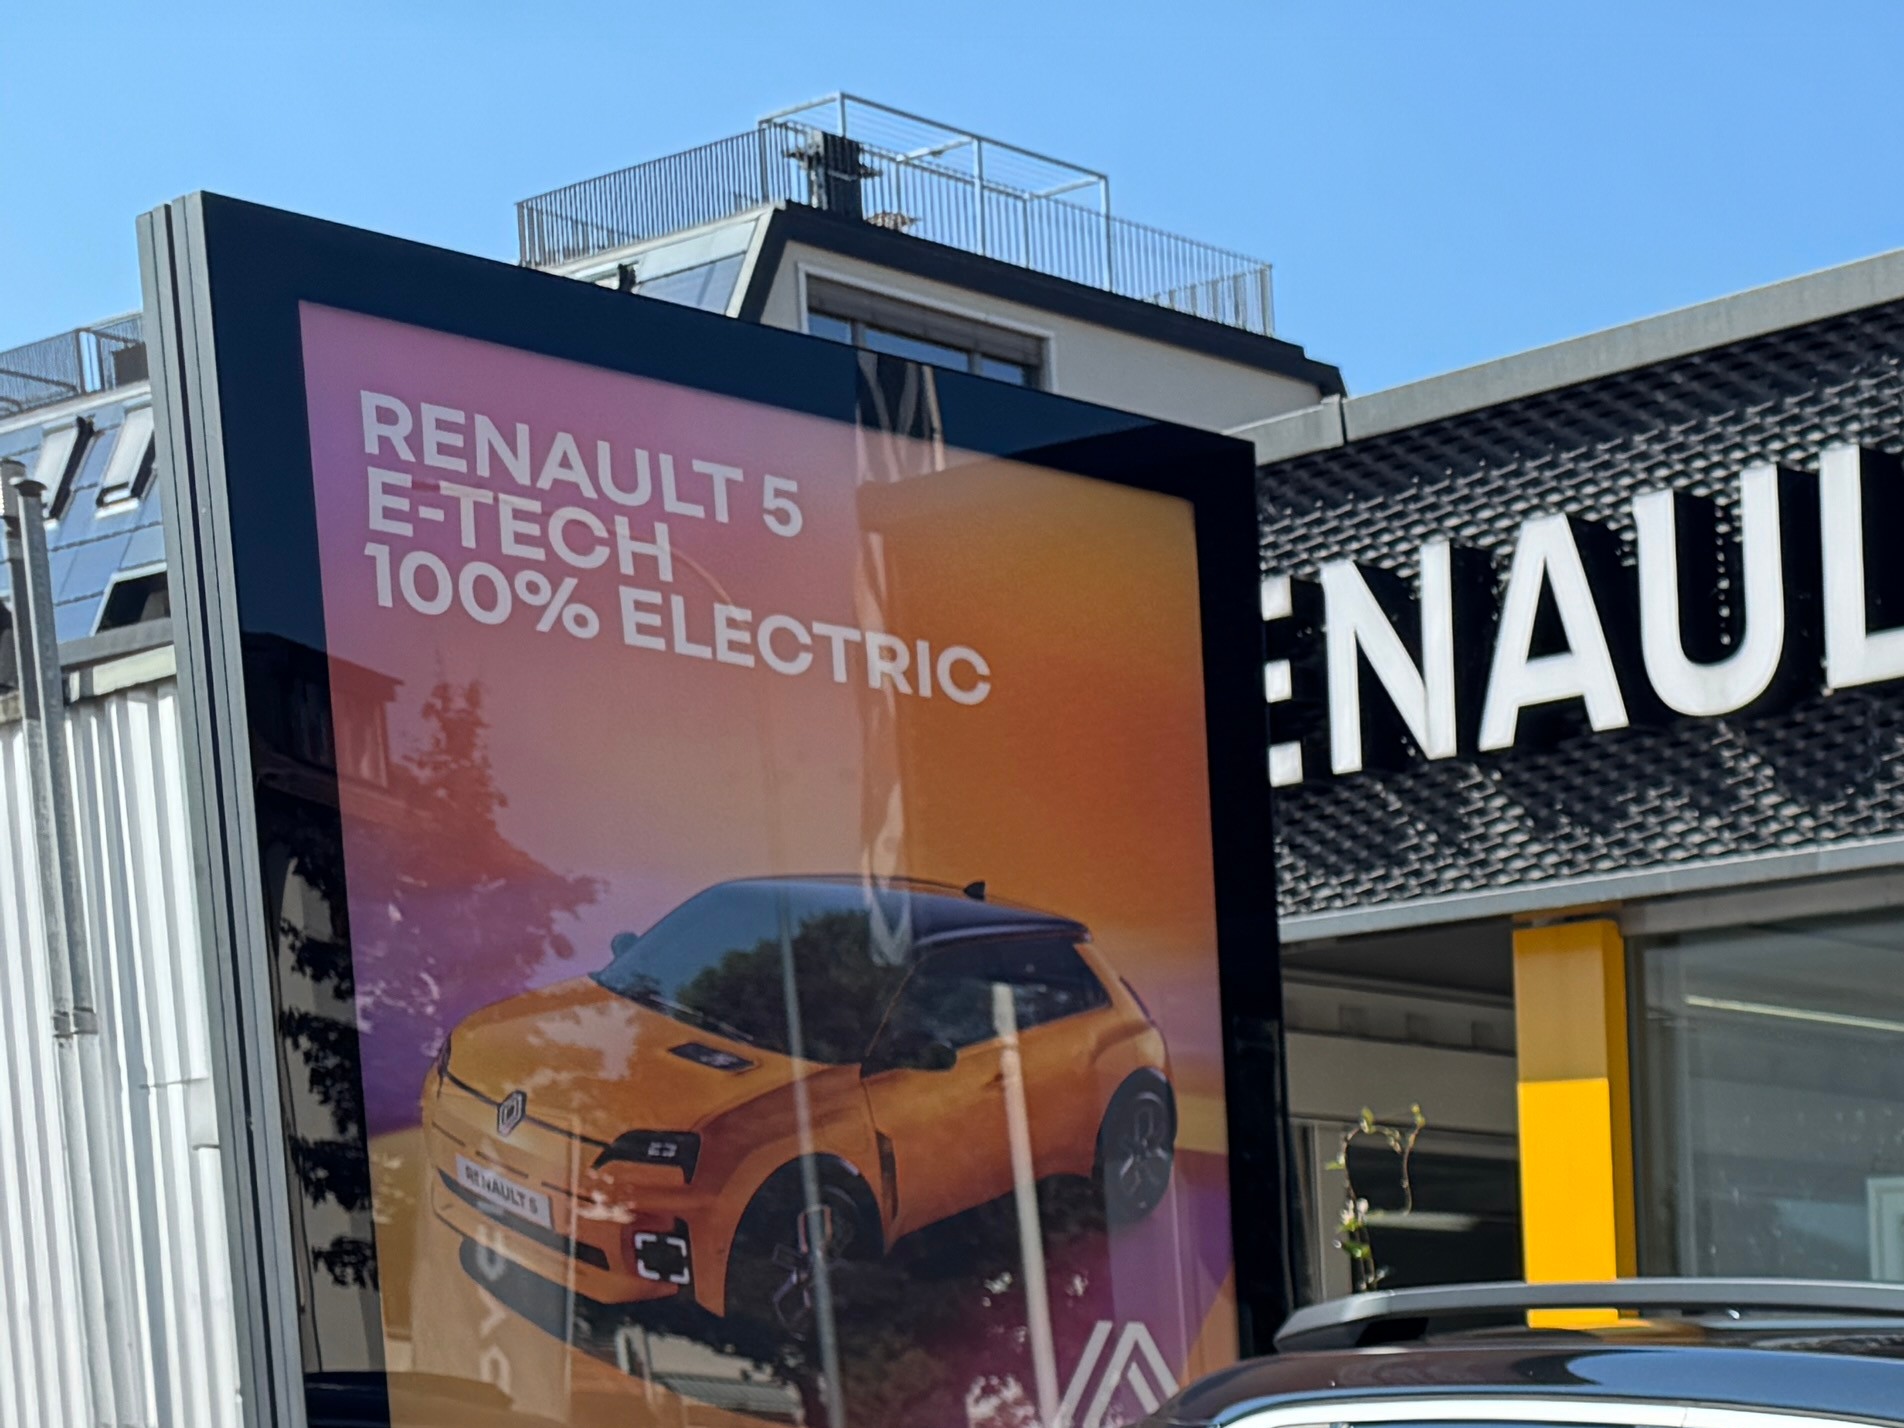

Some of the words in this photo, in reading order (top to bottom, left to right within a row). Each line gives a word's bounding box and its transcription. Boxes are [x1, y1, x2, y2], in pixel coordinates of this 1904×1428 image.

[360, 390, 743, 522] RENAULT
[762, 474, 802, 536] 5
[367, 465, 673, 582] E-TECH
[364, 543, 599, 639] 100%
[619, 585, 990, 704] ELECTRIC
[464, 1164, 527, 1207] RENAULT
